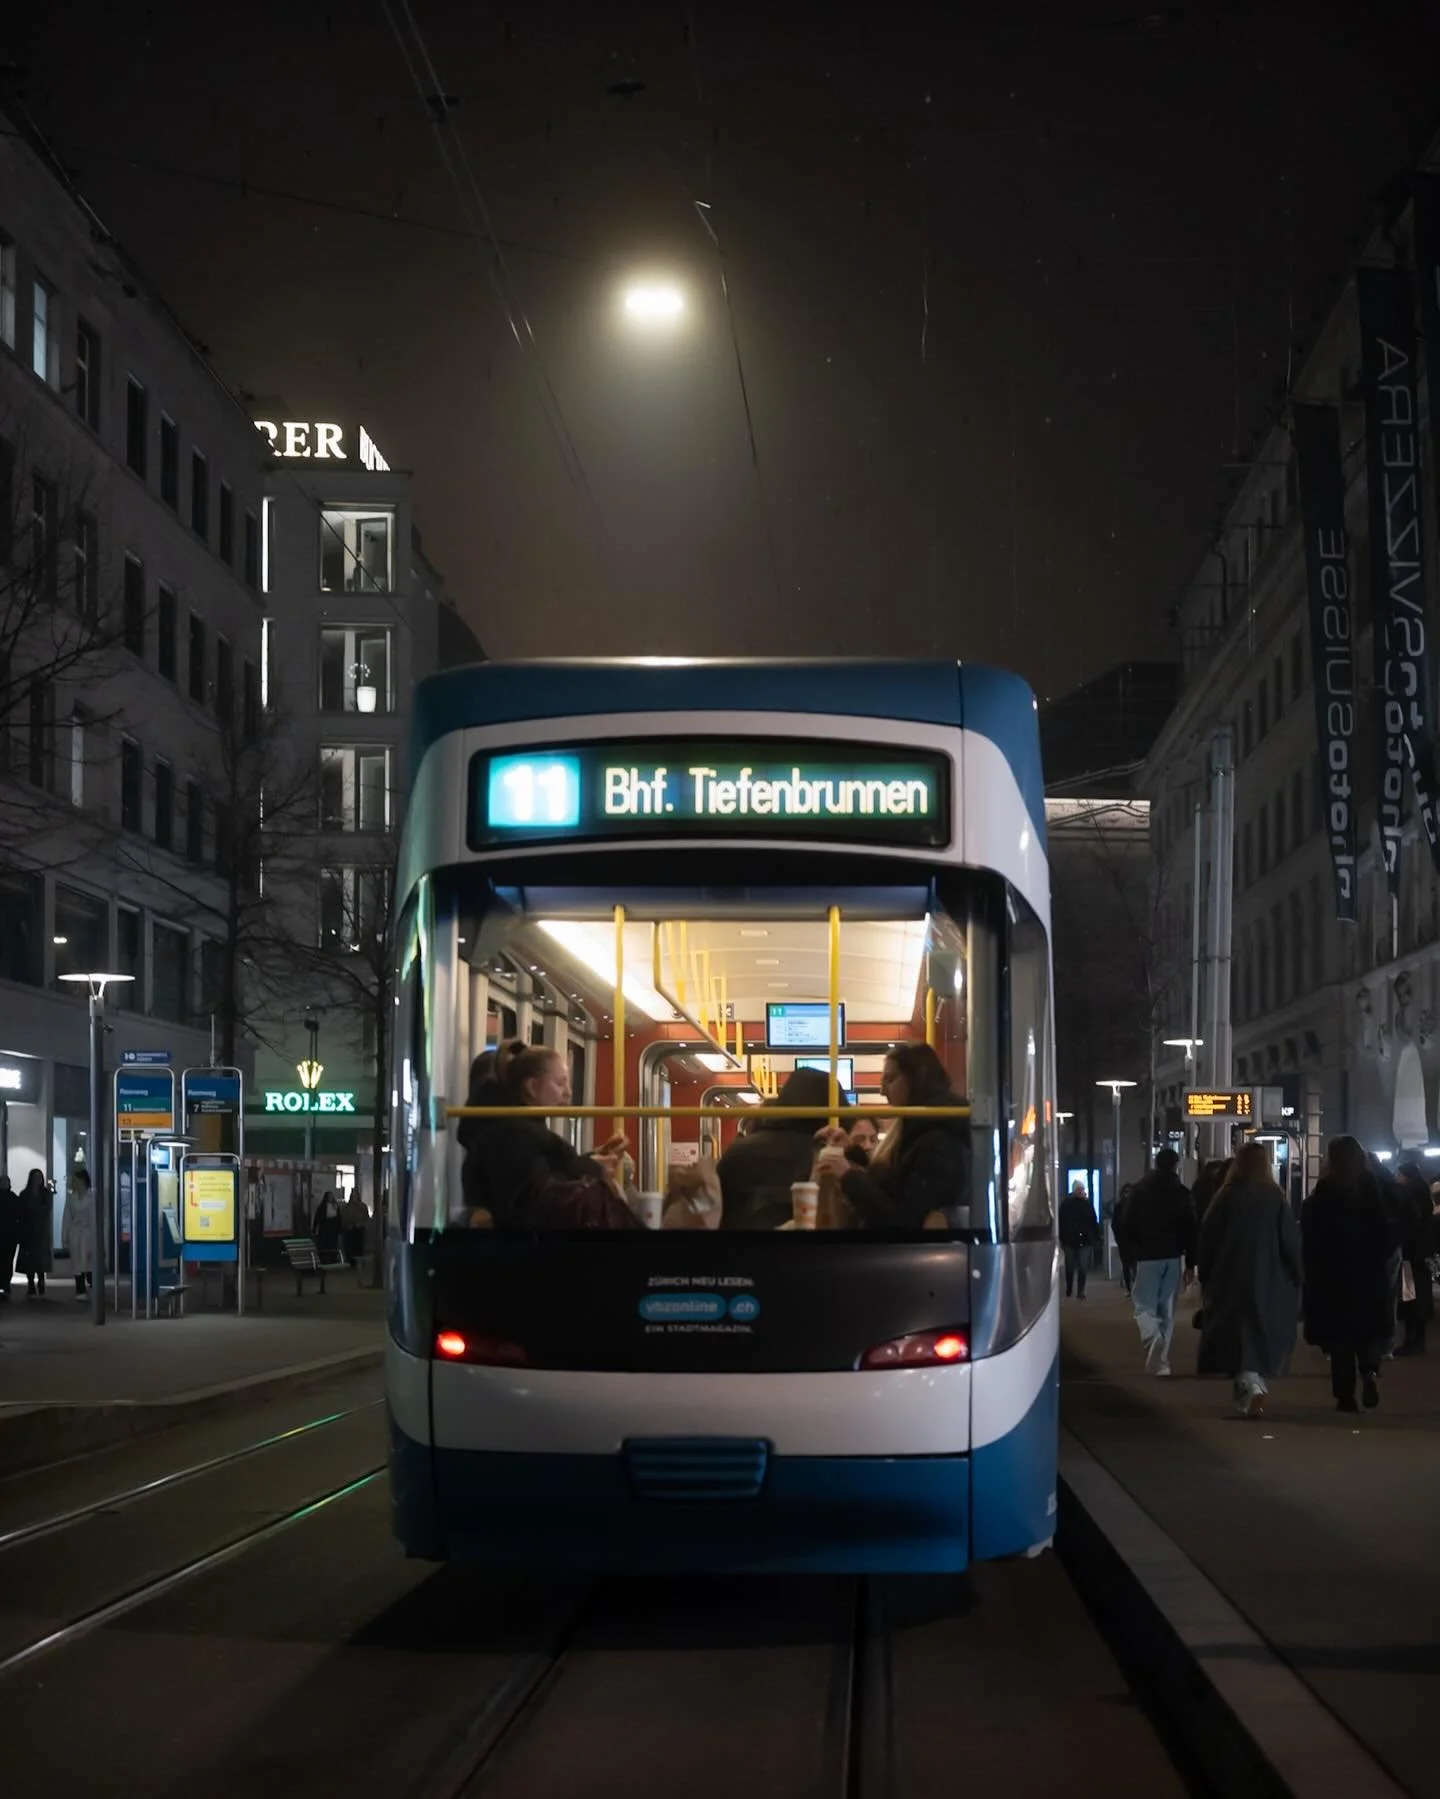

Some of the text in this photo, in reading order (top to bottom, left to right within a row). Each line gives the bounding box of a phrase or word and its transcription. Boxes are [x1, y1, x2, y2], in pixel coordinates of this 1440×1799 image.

[503, 763, 929, 822] 11 Bhf. Tiefenbrunnen
[264, 1092, 356, 1112] ROLEX
